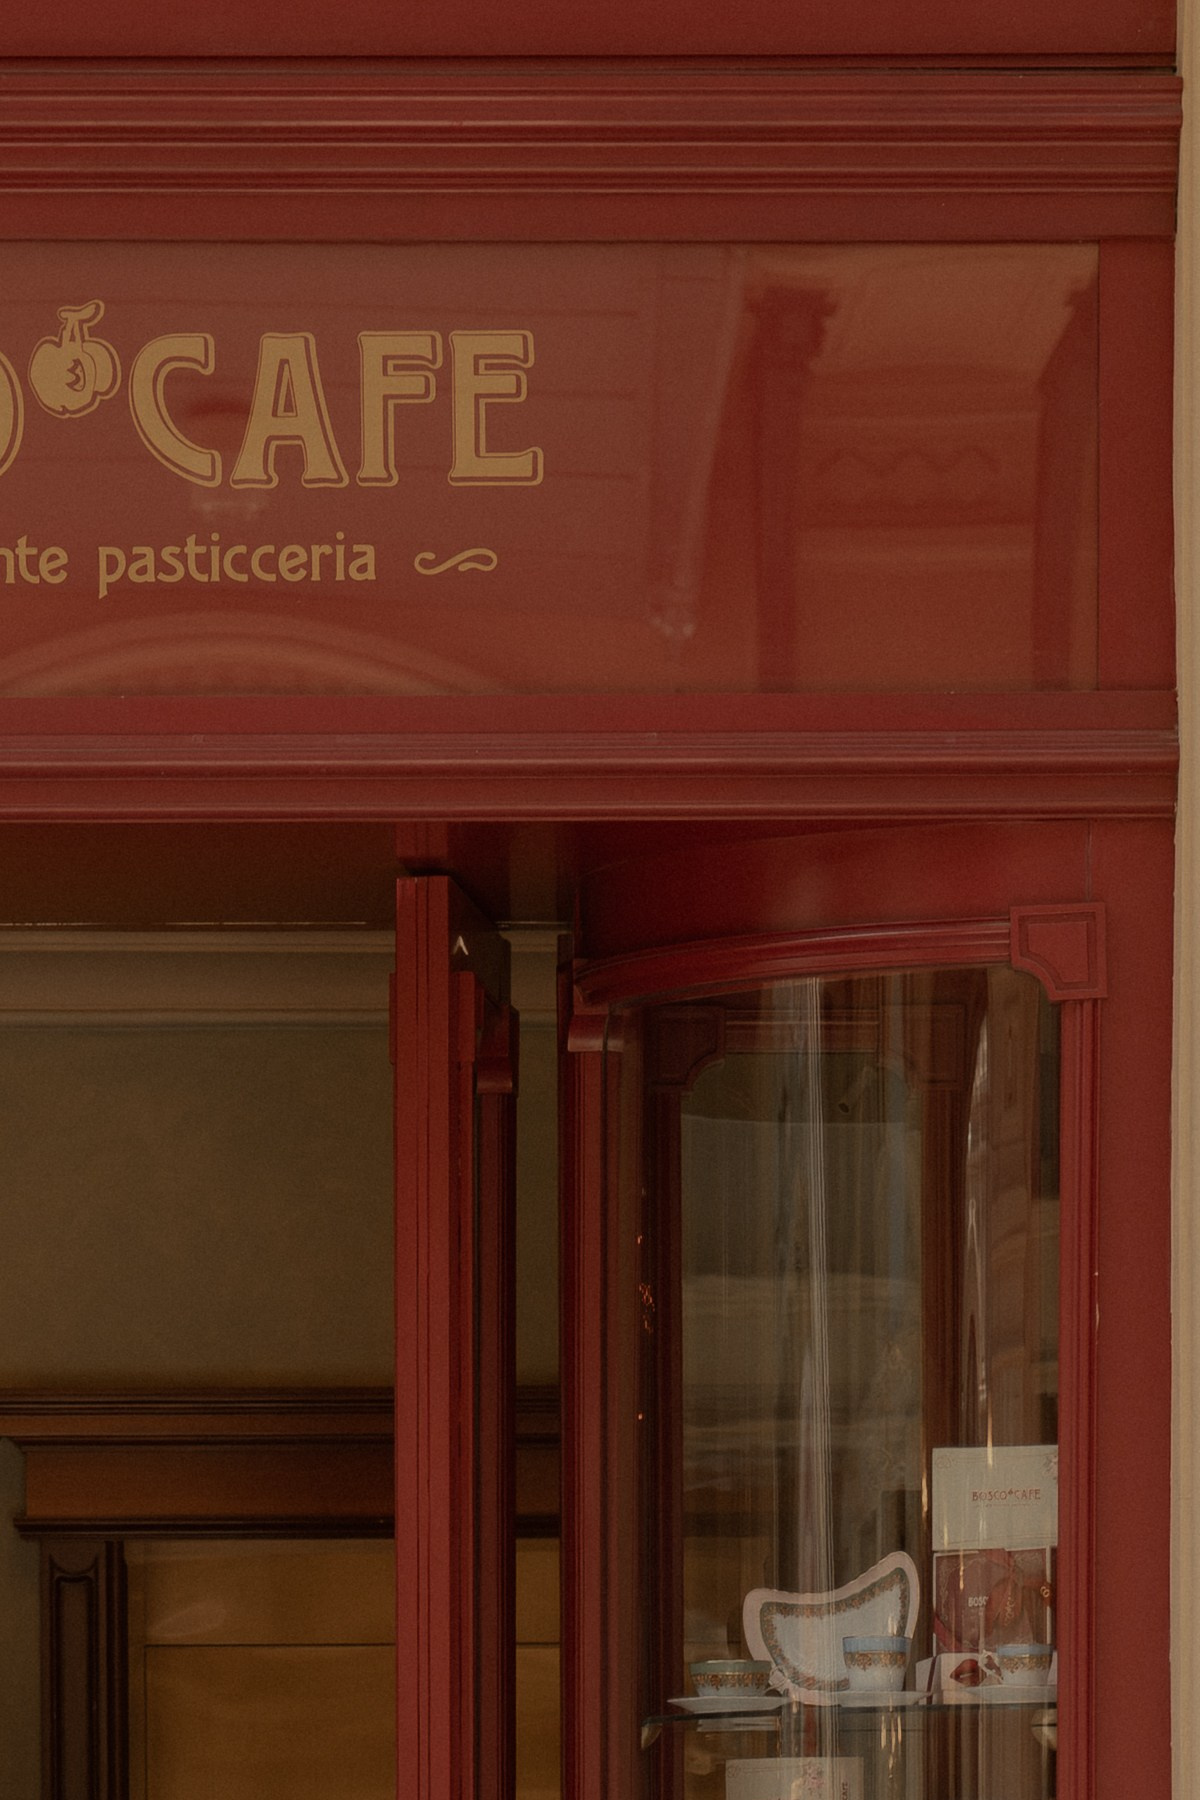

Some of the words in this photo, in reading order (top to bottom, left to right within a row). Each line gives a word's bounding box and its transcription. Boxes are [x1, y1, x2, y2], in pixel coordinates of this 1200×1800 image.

[127, 330, 544, 489] CAFE
[97, 531, 376, 597] pasticceria
[972, 1490, 1008, 1502] BOSCO
[1014, 1488, 1041, 1500] CAFE
[967, 1595, 989, 1607] BOSC
